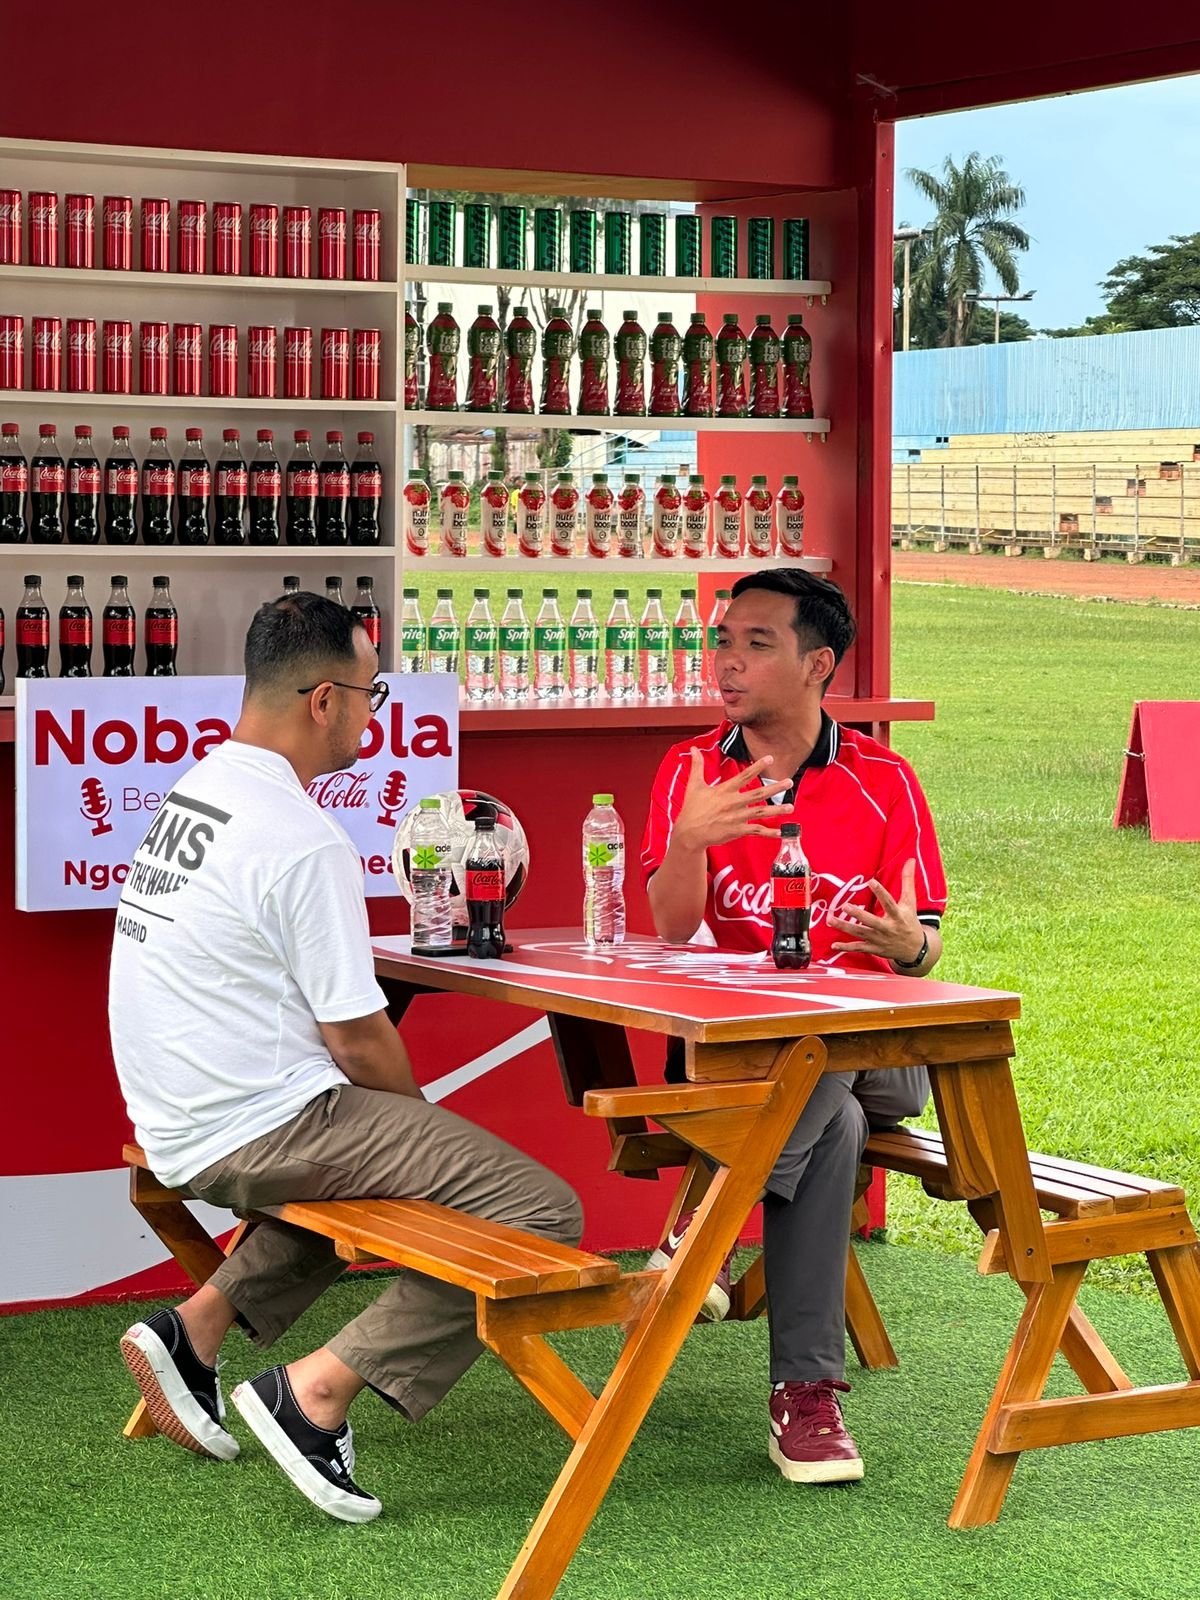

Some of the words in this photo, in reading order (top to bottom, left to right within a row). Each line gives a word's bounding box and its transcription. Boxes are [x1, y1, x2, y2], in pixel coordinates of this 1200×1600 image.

[35, 705, 231, 765] Noba
[357, 702, 453, 760] ola
[123, 788, 167, 812] Be
[305, 771, 375, 809] a-Cola
[138, 808, 215, 872] ANS
[64, 859, 132, 894] Ngo
